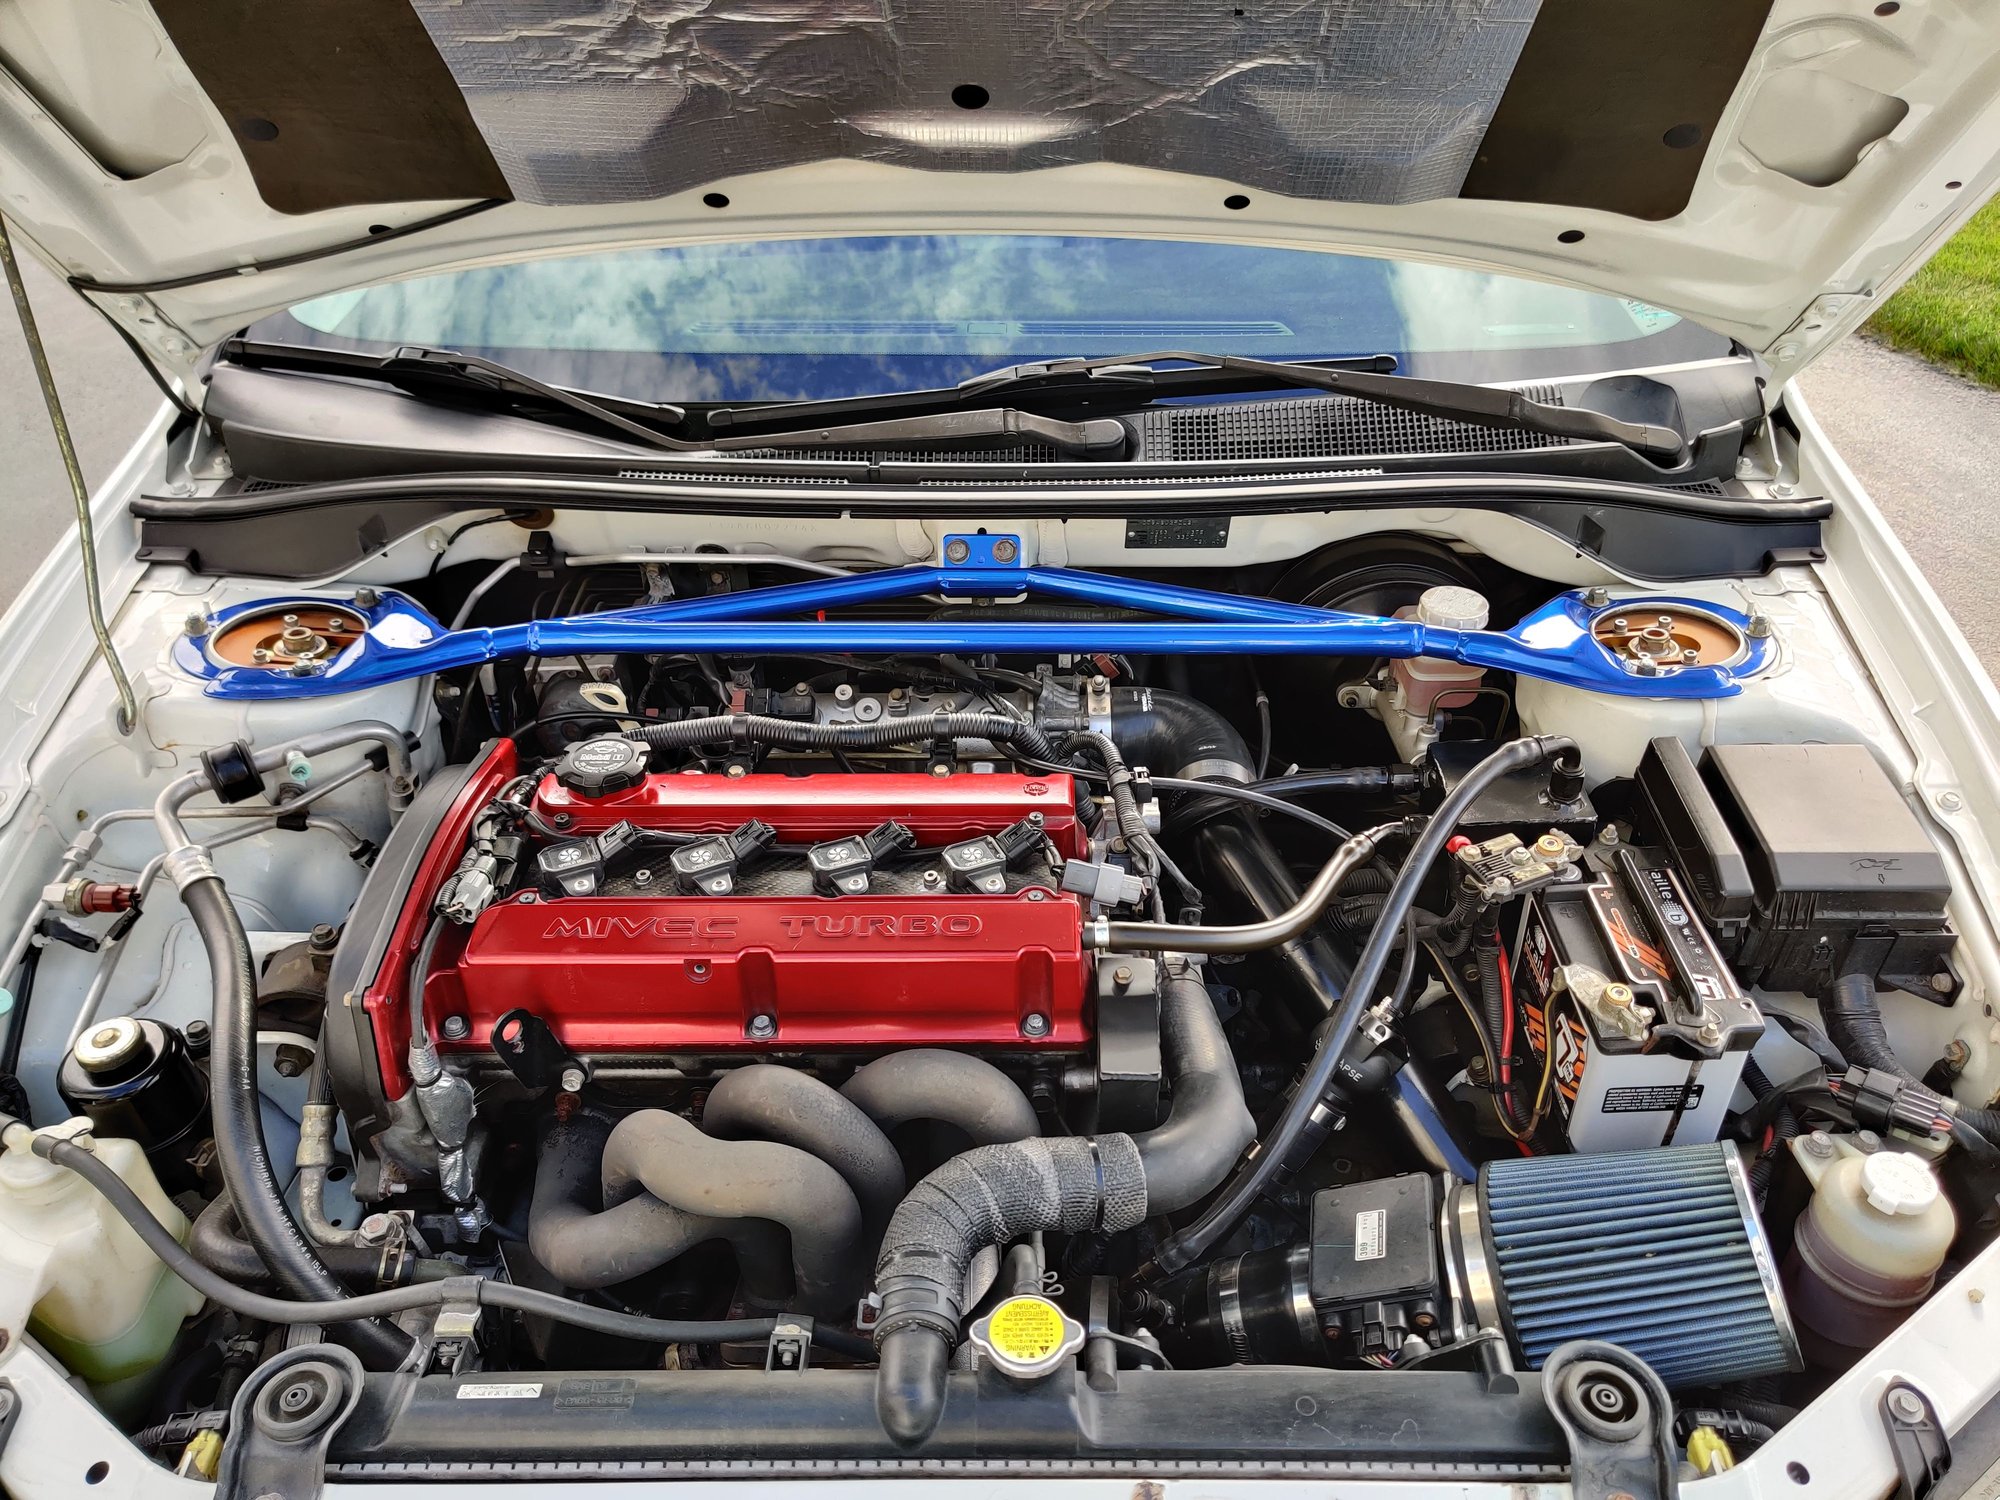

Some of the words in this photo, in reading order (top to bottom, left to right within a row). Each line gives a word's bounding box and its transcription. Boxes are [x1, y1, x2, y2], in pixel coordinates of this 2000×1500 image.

[1650, 872, 1672, 900] aille
[542, 916, 740, 939] MIVEC
[779, 914, 983, 938] TURBO
[1338, 1058, 1363, 1082] APSE
[252, 1145, 273, 1189] NICHIRIN
[269, 1192, 284, 1213] JPN
